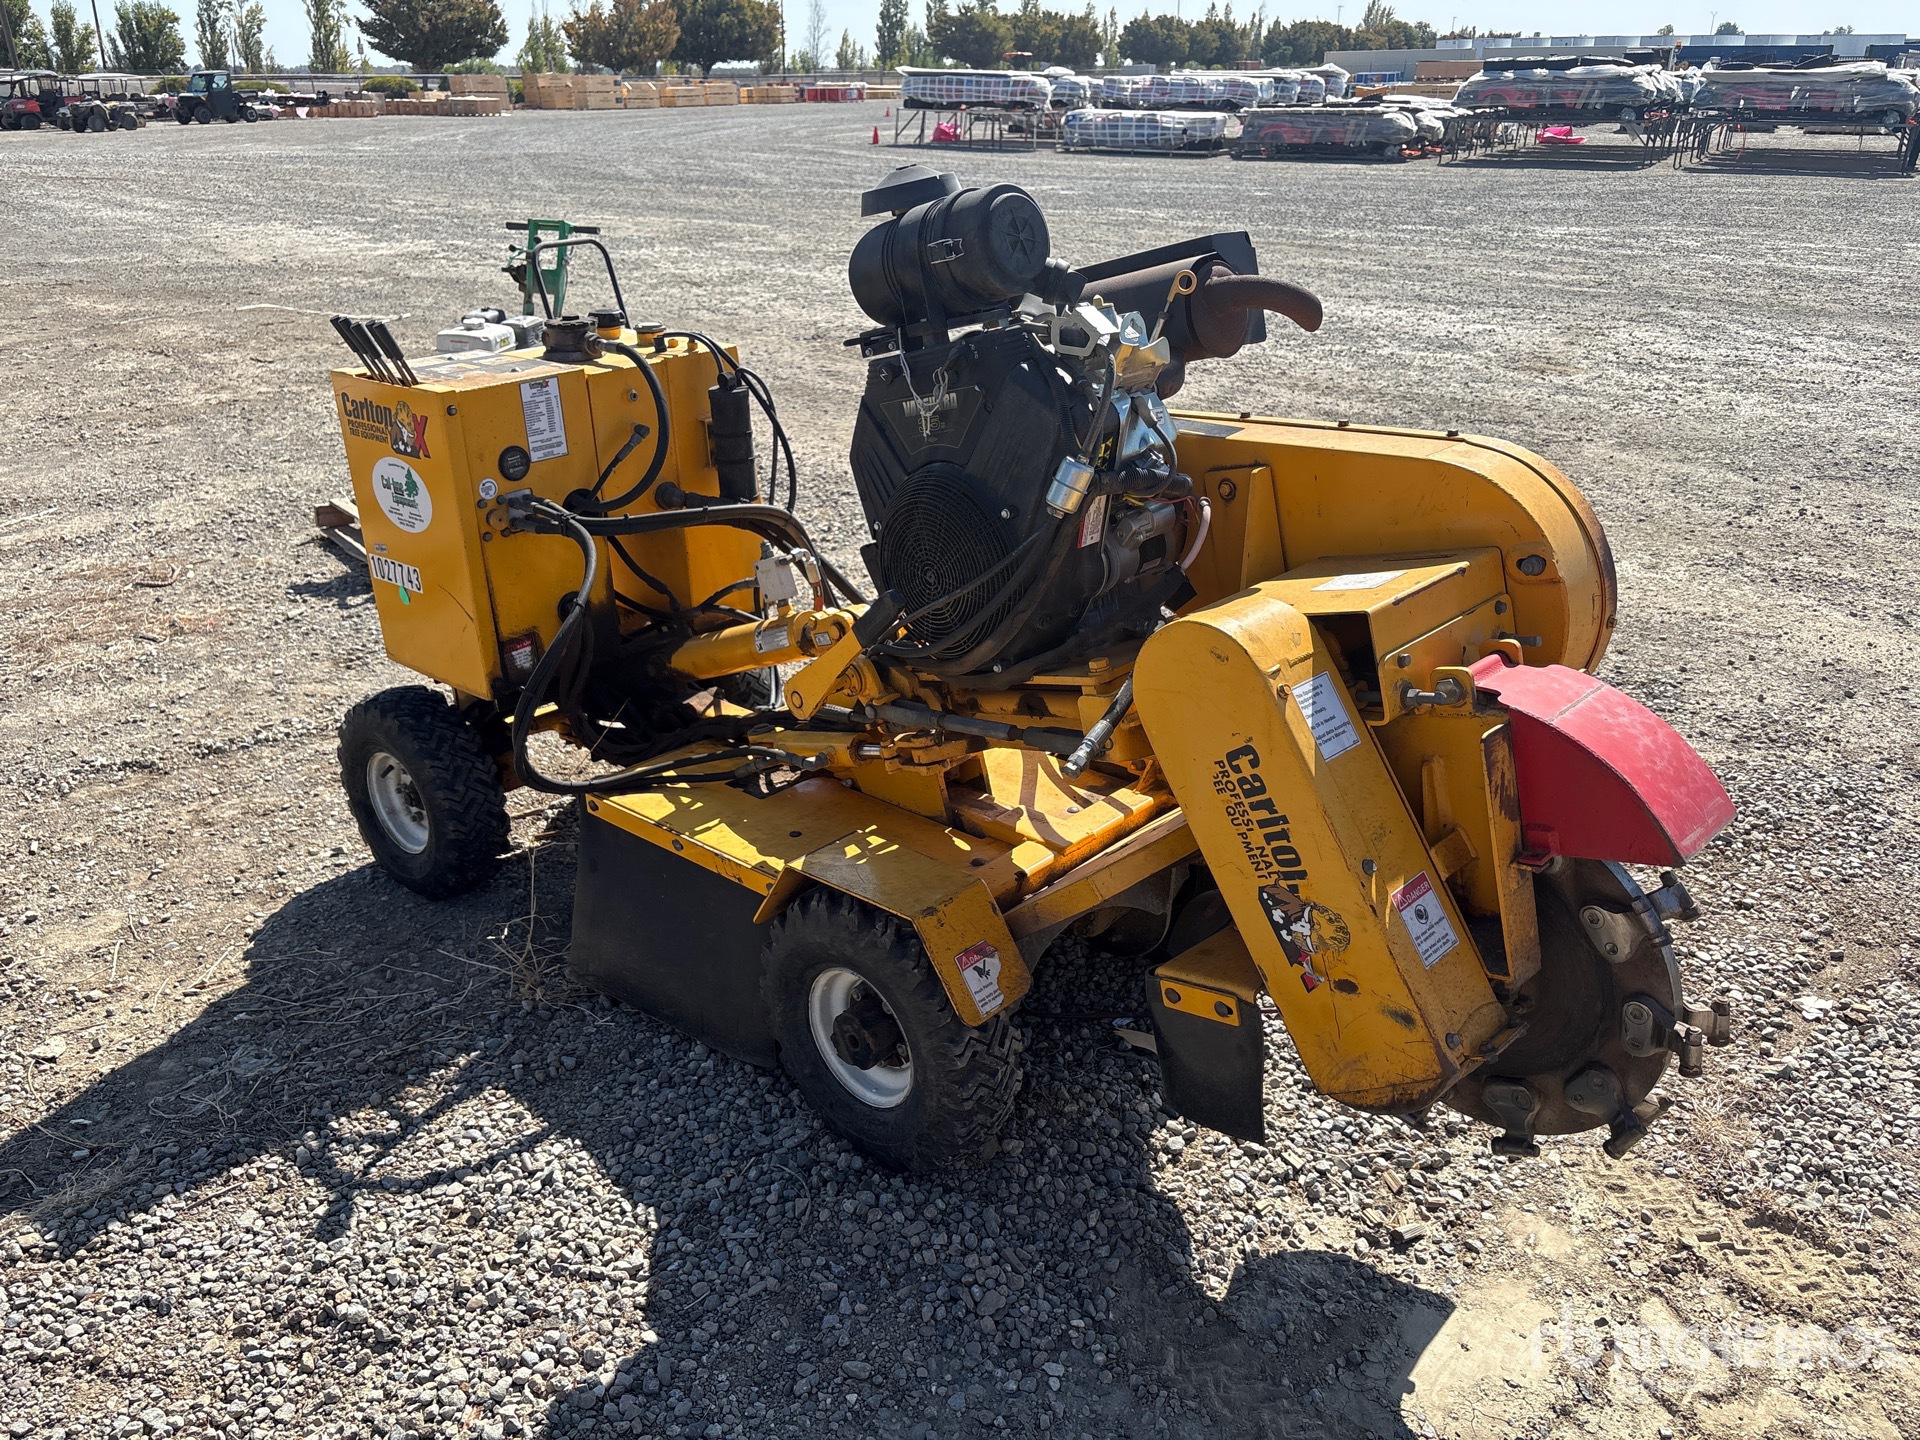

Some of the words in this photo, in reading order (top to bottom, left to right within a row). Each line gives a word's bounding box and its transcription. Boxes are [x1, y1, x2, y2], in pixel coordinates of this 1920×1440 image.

[902, 392, 958, 417] VAGURD
[341, 392, 392, 428] Carlton
[412, 413, 431, 458] X
[347, 419, 388, 436] PROFESSIONAL
[349, 428, 360, 437] TREE
[361, 430, 389, 444] EQUIPMENT
[371, 555, 421, 591] 1027743
[1214, 760, 1280, 879] PROFESSINAL
[1226, 744, 1308, 895] Carlton
[1226, 805, 1268, 880] QUPMENT
[1406, 882, 1430, 902] DANGER
